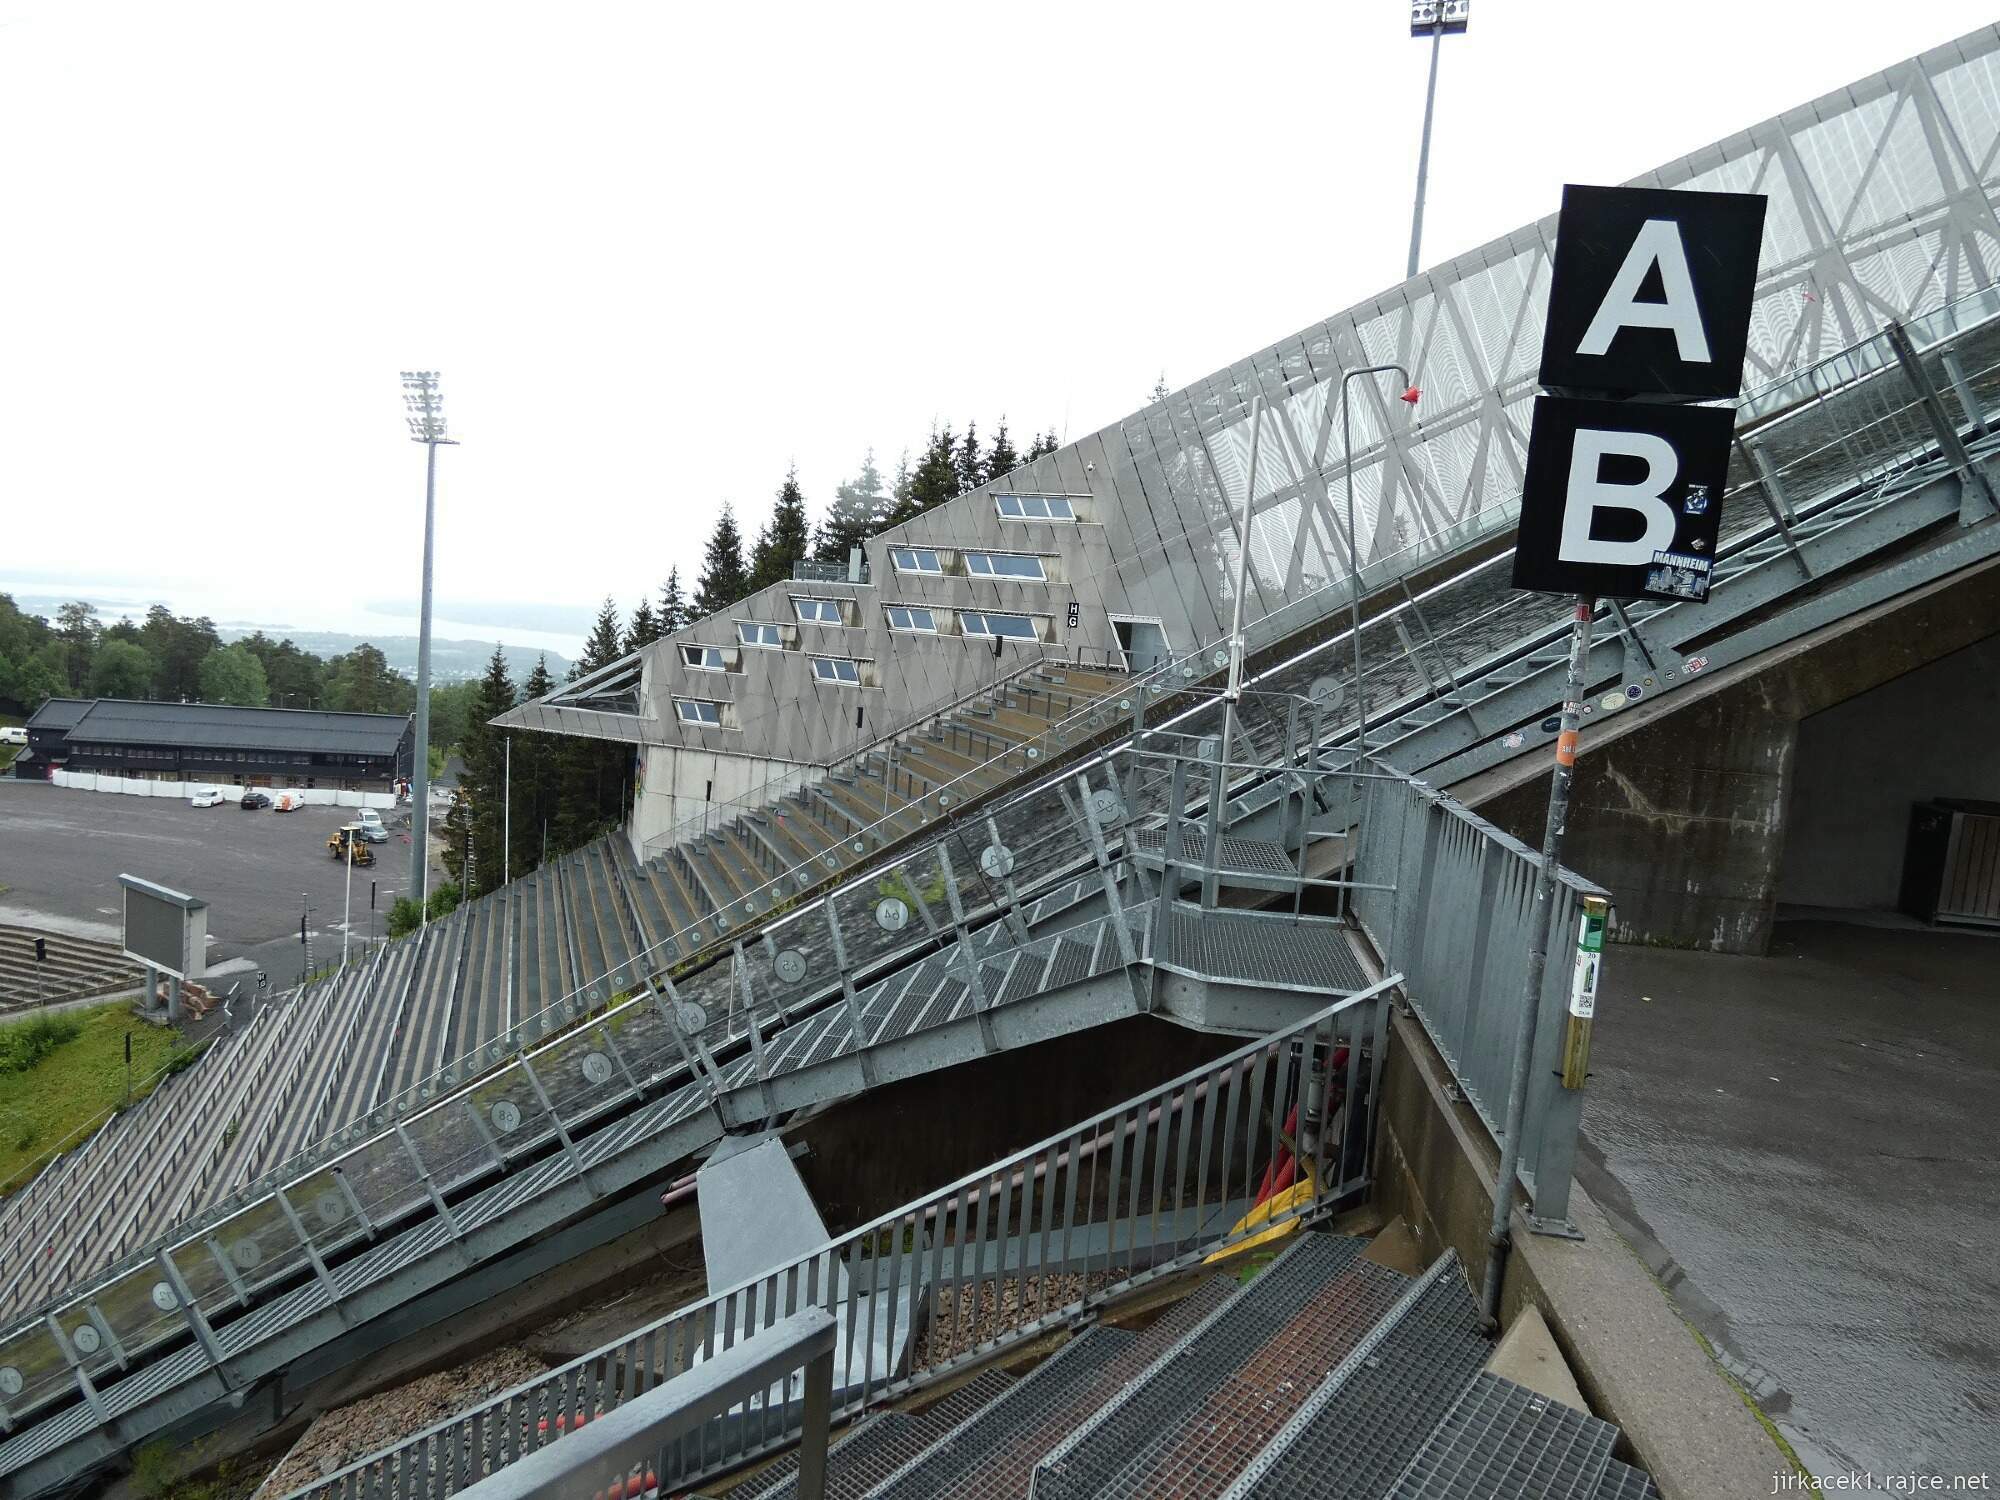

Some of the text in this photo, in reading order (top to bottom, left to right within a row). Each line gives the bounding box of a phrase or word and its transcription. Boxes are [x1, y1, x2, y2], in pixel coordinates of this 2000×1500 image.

[1576, 219, 1711, 363] A
[1558, 428, 1678, 566] B
[1653, 551, 1709, 572] MANNHEIM
[1070, 604, 1078, 613] H
[1069, 617, 1077, 626] G
